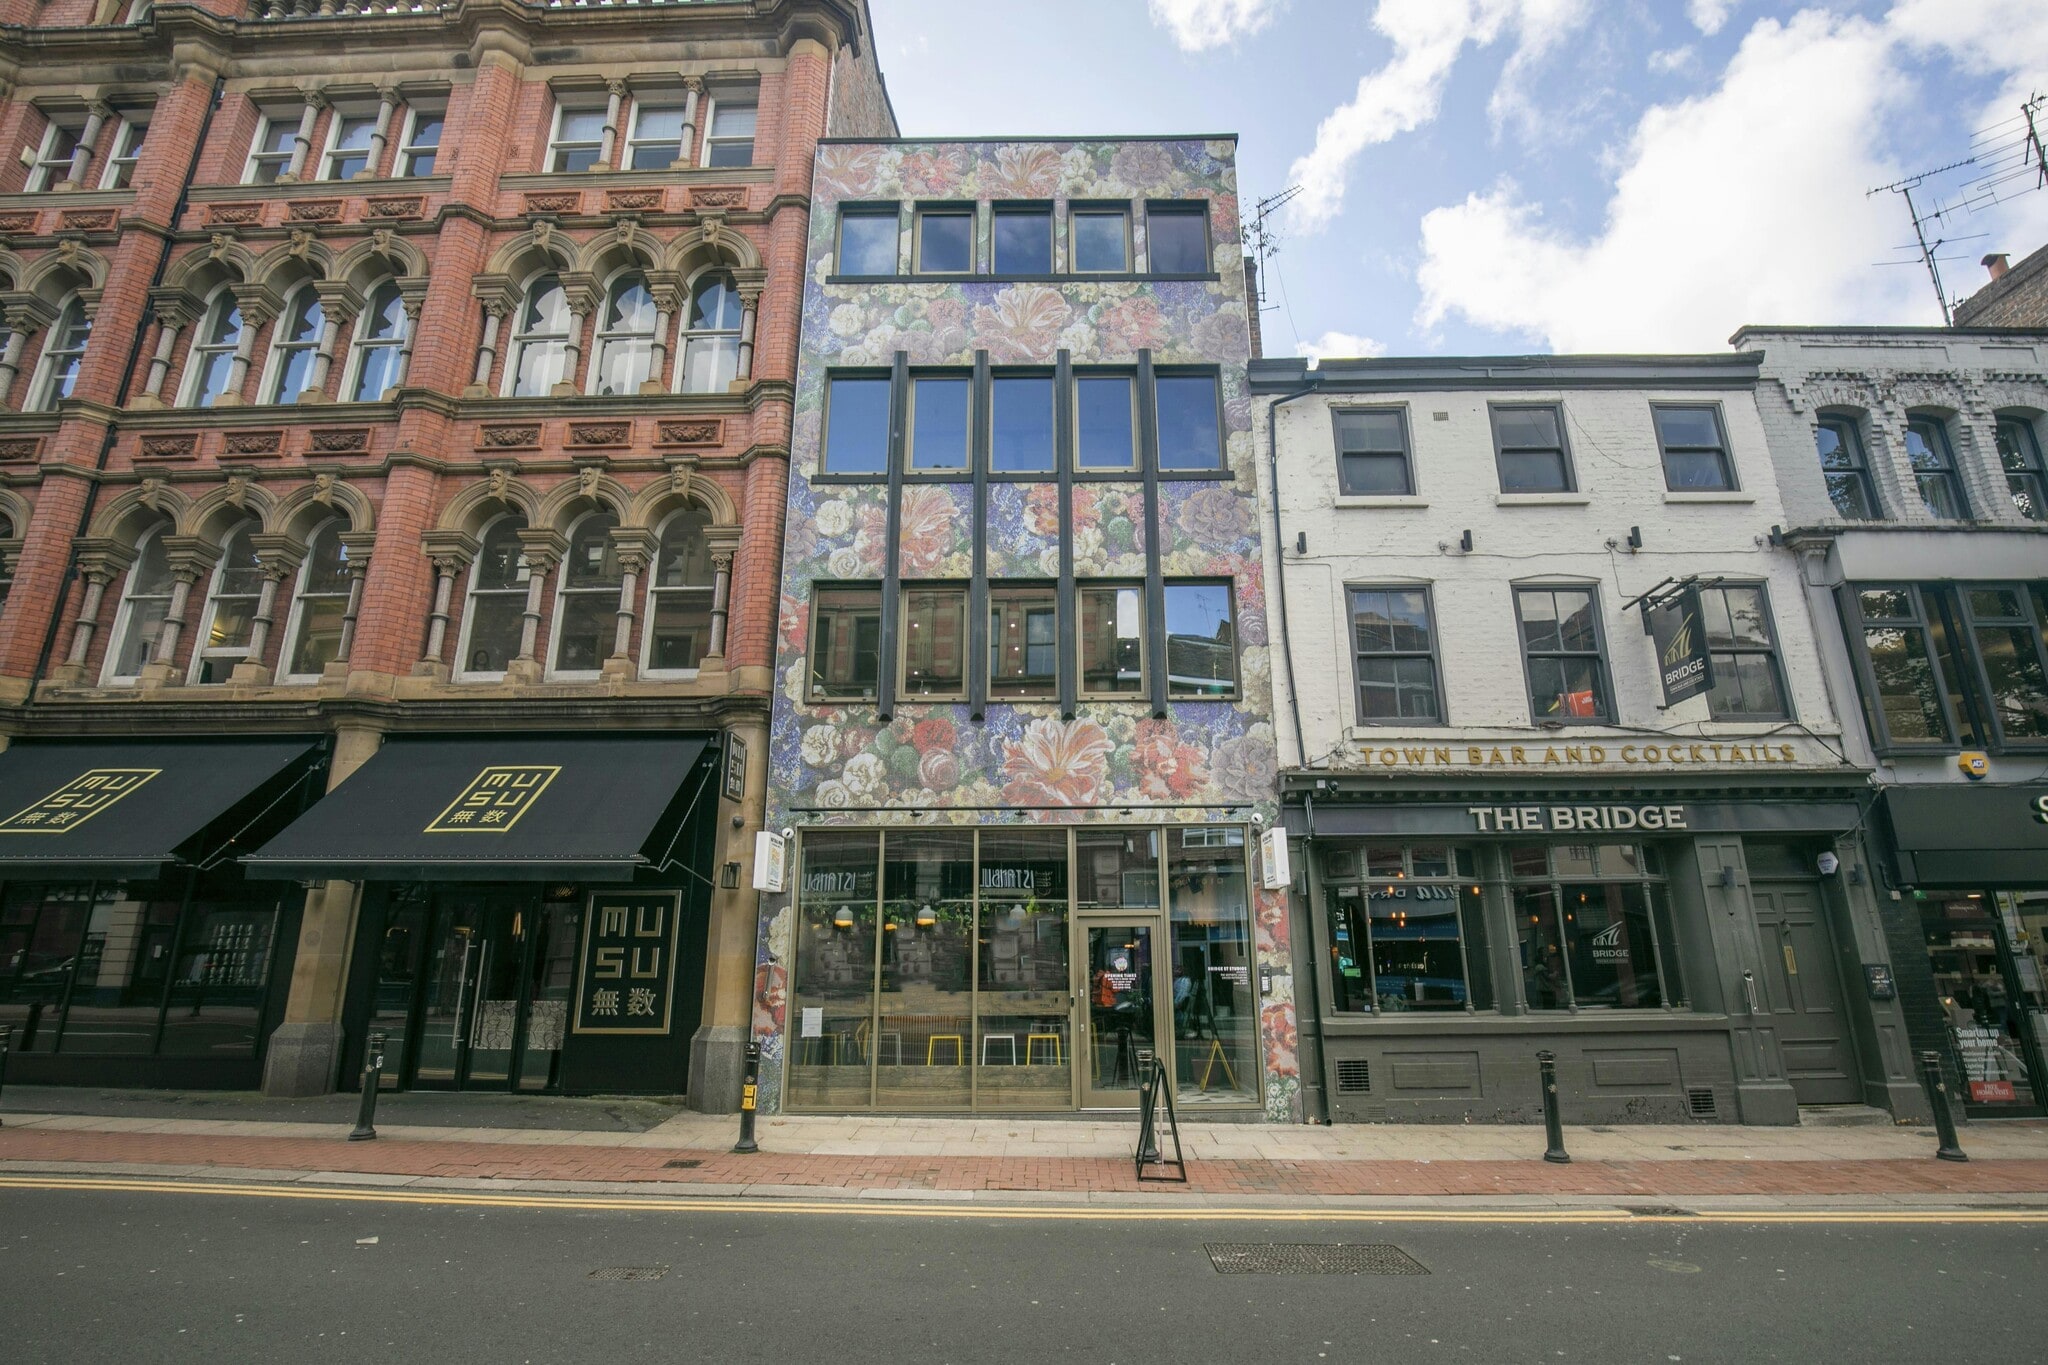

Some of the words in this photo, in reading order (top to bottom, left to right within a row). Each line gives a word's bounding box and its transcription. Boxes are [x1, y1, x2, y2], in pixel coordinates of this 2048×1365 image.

[1665, 657, 1705, 685] BRIDGE
[1360, 746, 1451, 767] TOWN
[1467, 745, 1526, 766] BAR
[1544, 745, 1606, 764] AND
[1621, 743, 1796, 764] COCKTAILS
[43, 794, 111, 808] SU
[463, 791, 527, 806] SU
[1469, 806, 1543, 831] THE
[1551, 805, 1687, 830] BRIDGE
[599, 906, 664, 937] MU
[595, 947, 660, 978] SU
[1592, 949, 1629, 958] BRIDGE
[591, 987, 657, 1016] 無数
[1956, 1027, 1988, 1038] Smarten
[1989, 1028, 2000, 1038] up
[1959, 1039, 1976, 1049] your
